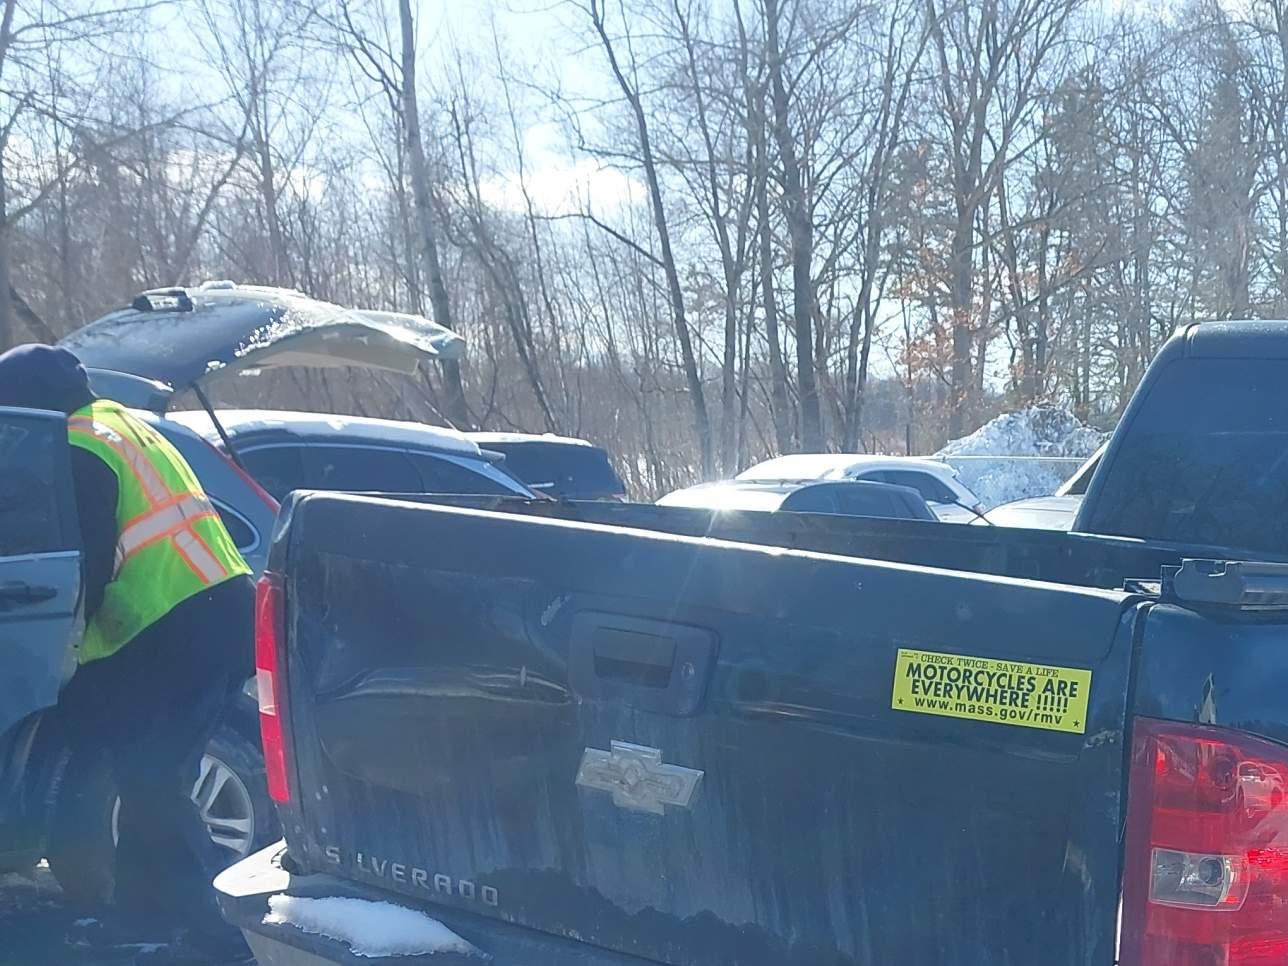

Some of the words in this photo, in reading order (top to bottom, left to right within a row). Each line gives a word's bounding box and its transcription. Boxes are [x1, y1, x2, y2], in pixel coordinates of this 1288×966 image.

[905, 662, 1037, 693] MOTORCYCLES
[1041, 678, 1079, 698] ARE
[920, 654, 953, 666] CHECK
[956, 657, 989, 670] TWICE
[997, 663, 1024, 675] SAVE
[1025, 667, 1033, 675] A
[1035, 667, 1060, 678] LIFE
[911, 679, 1030, 709] EVERYWHERE
[914, 697, 1063, 725] www.mass.gov/rmv
[325, 847, 498, 906] SLVERADO
